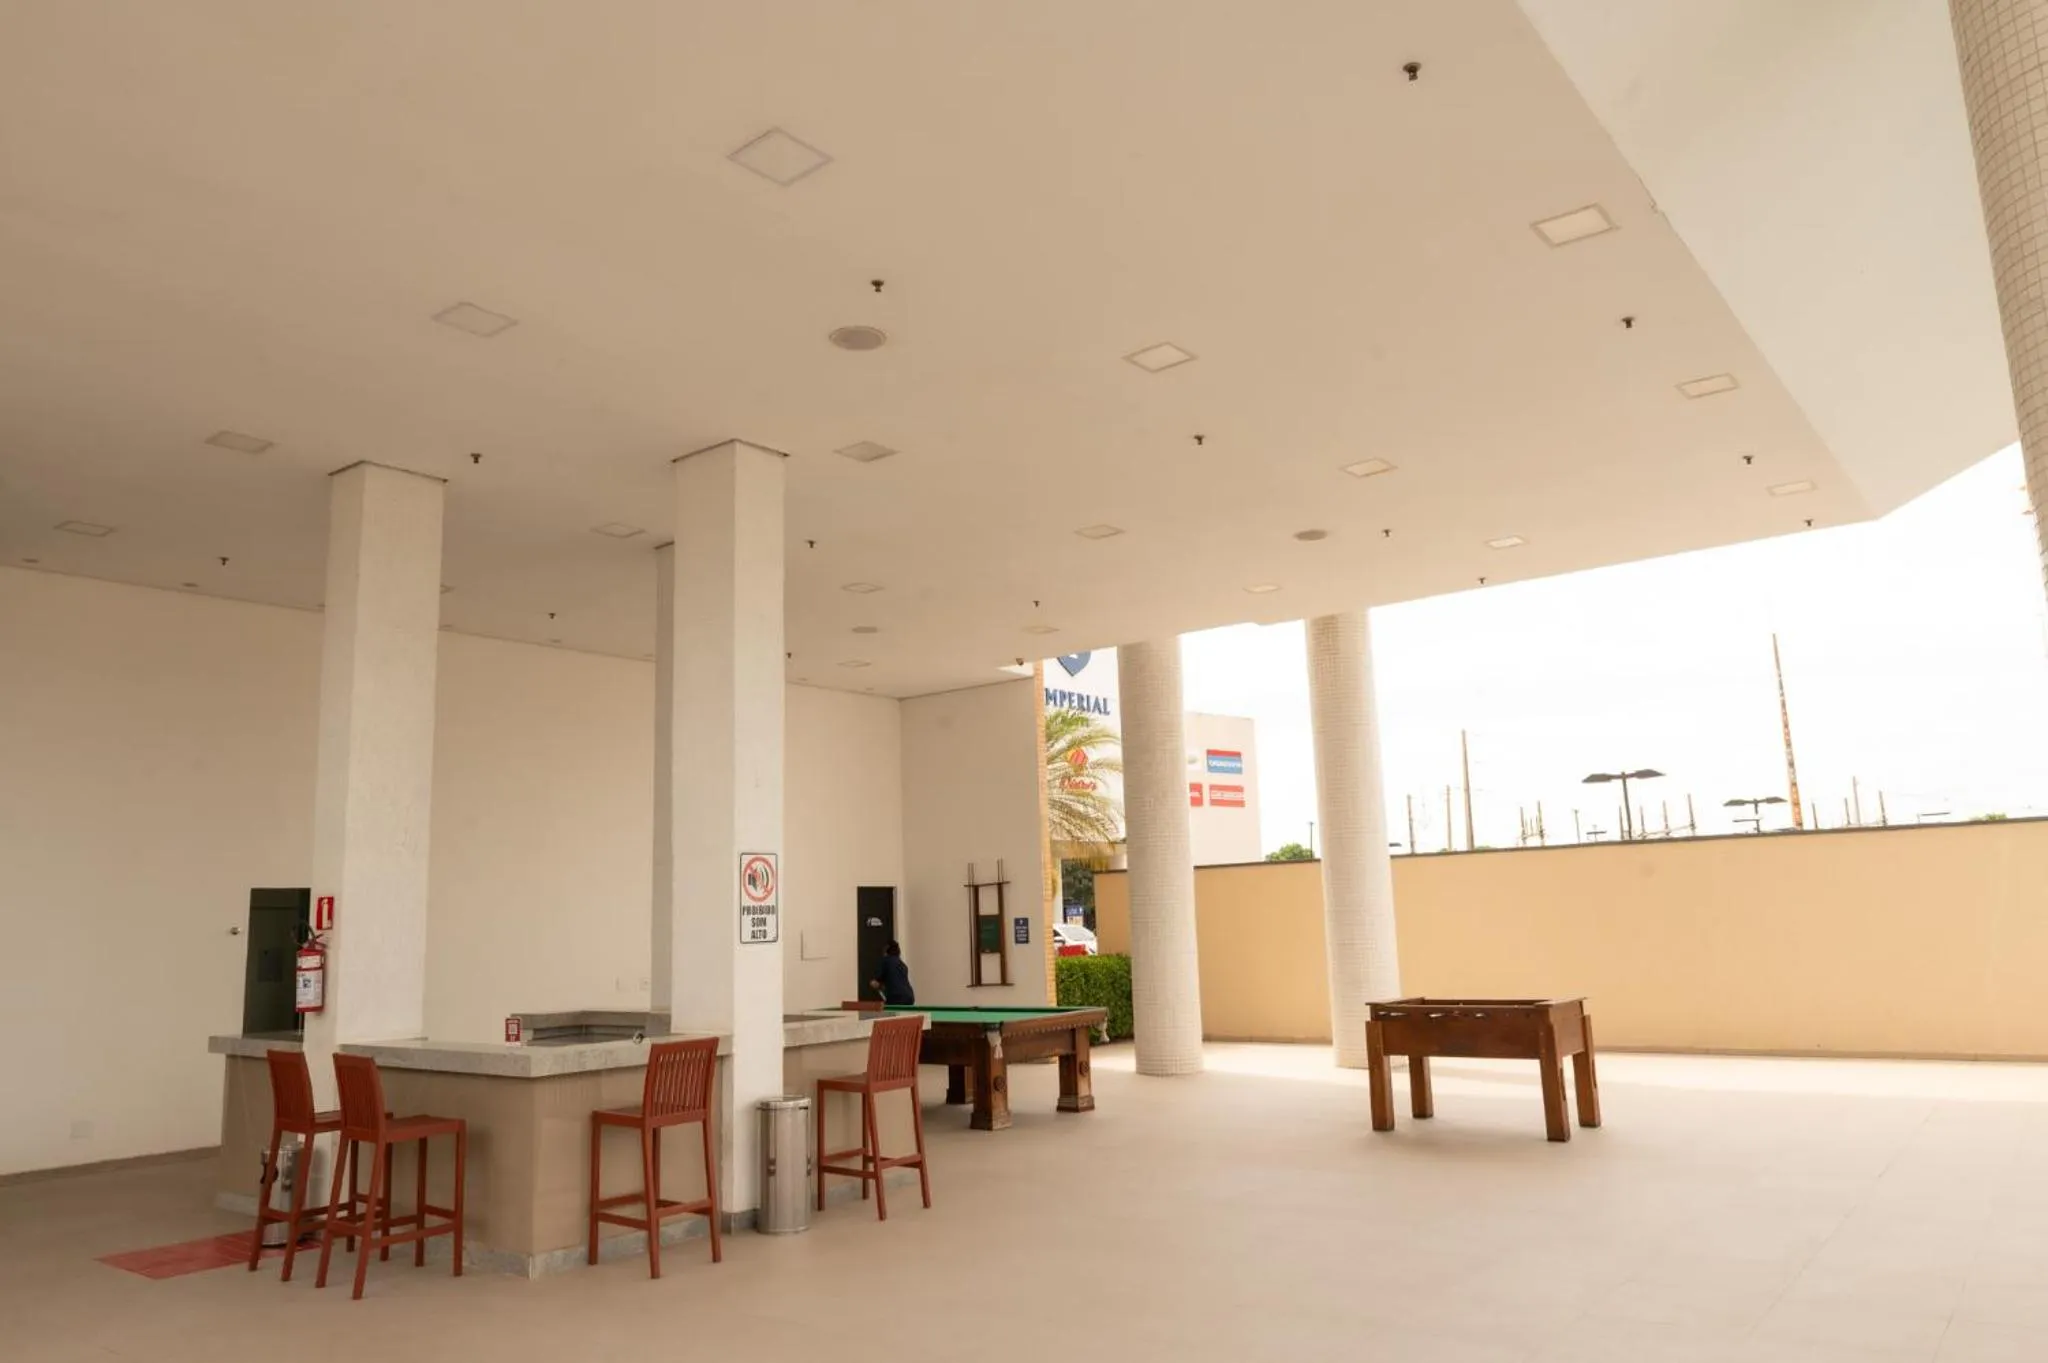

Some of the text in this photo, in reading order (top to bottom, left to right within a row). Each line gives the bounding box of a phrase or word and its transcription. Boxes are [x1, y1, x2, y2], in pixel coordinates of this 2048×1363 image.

[1045, 687, 1111, 716] MPERIAL
[742, 904, 775, 916] PROIBIDO
[750, 929, 767, 940] ALTO
